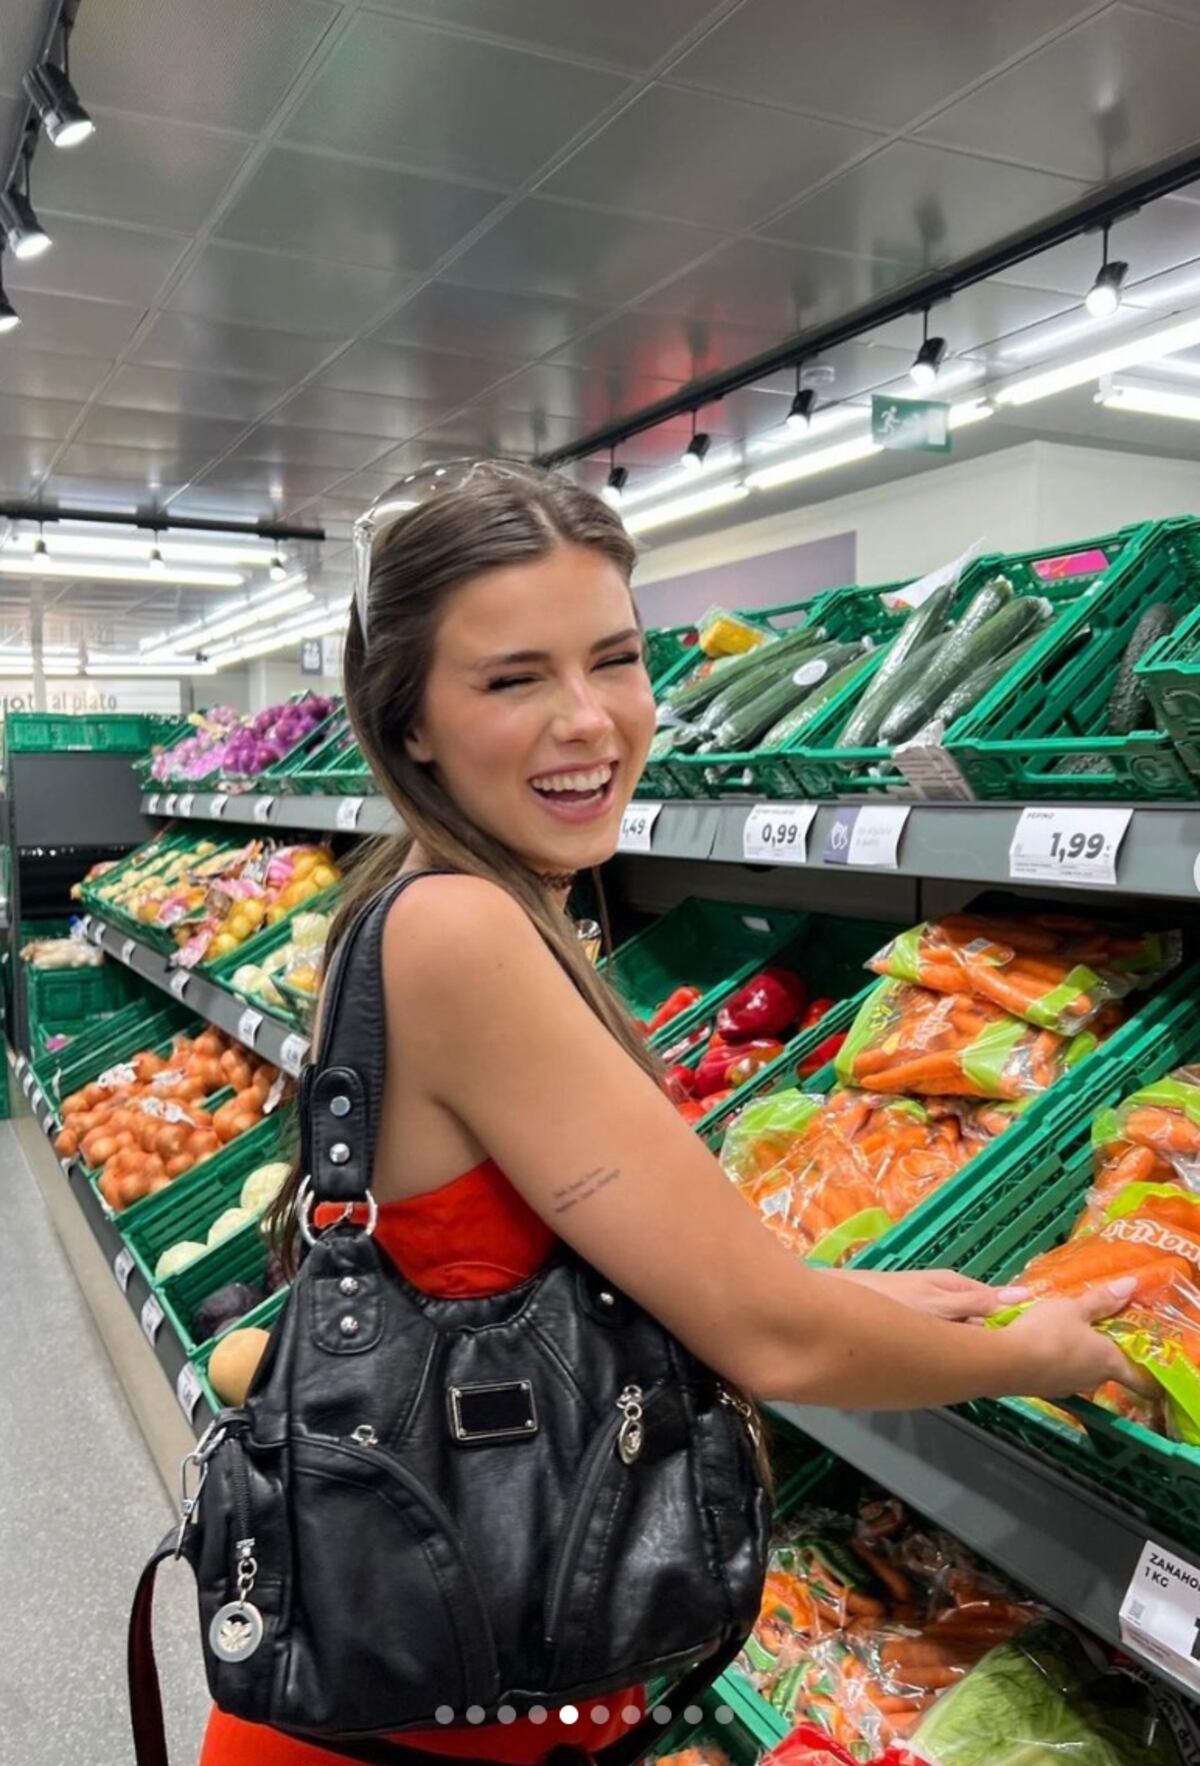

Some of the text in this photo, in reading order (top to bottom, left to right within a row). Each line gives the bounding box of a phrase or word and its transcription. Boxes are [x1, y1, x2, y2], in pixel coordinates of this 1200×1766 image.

[72, 691, 117, 714] plato
[762, 823, 798, 847] 0,99
[1050, 831, 1105, 862] 1,99
[1100, 1218, 1200, 1270] HORIAS
[1145, 1566, 1169, 1588] 1 KG
